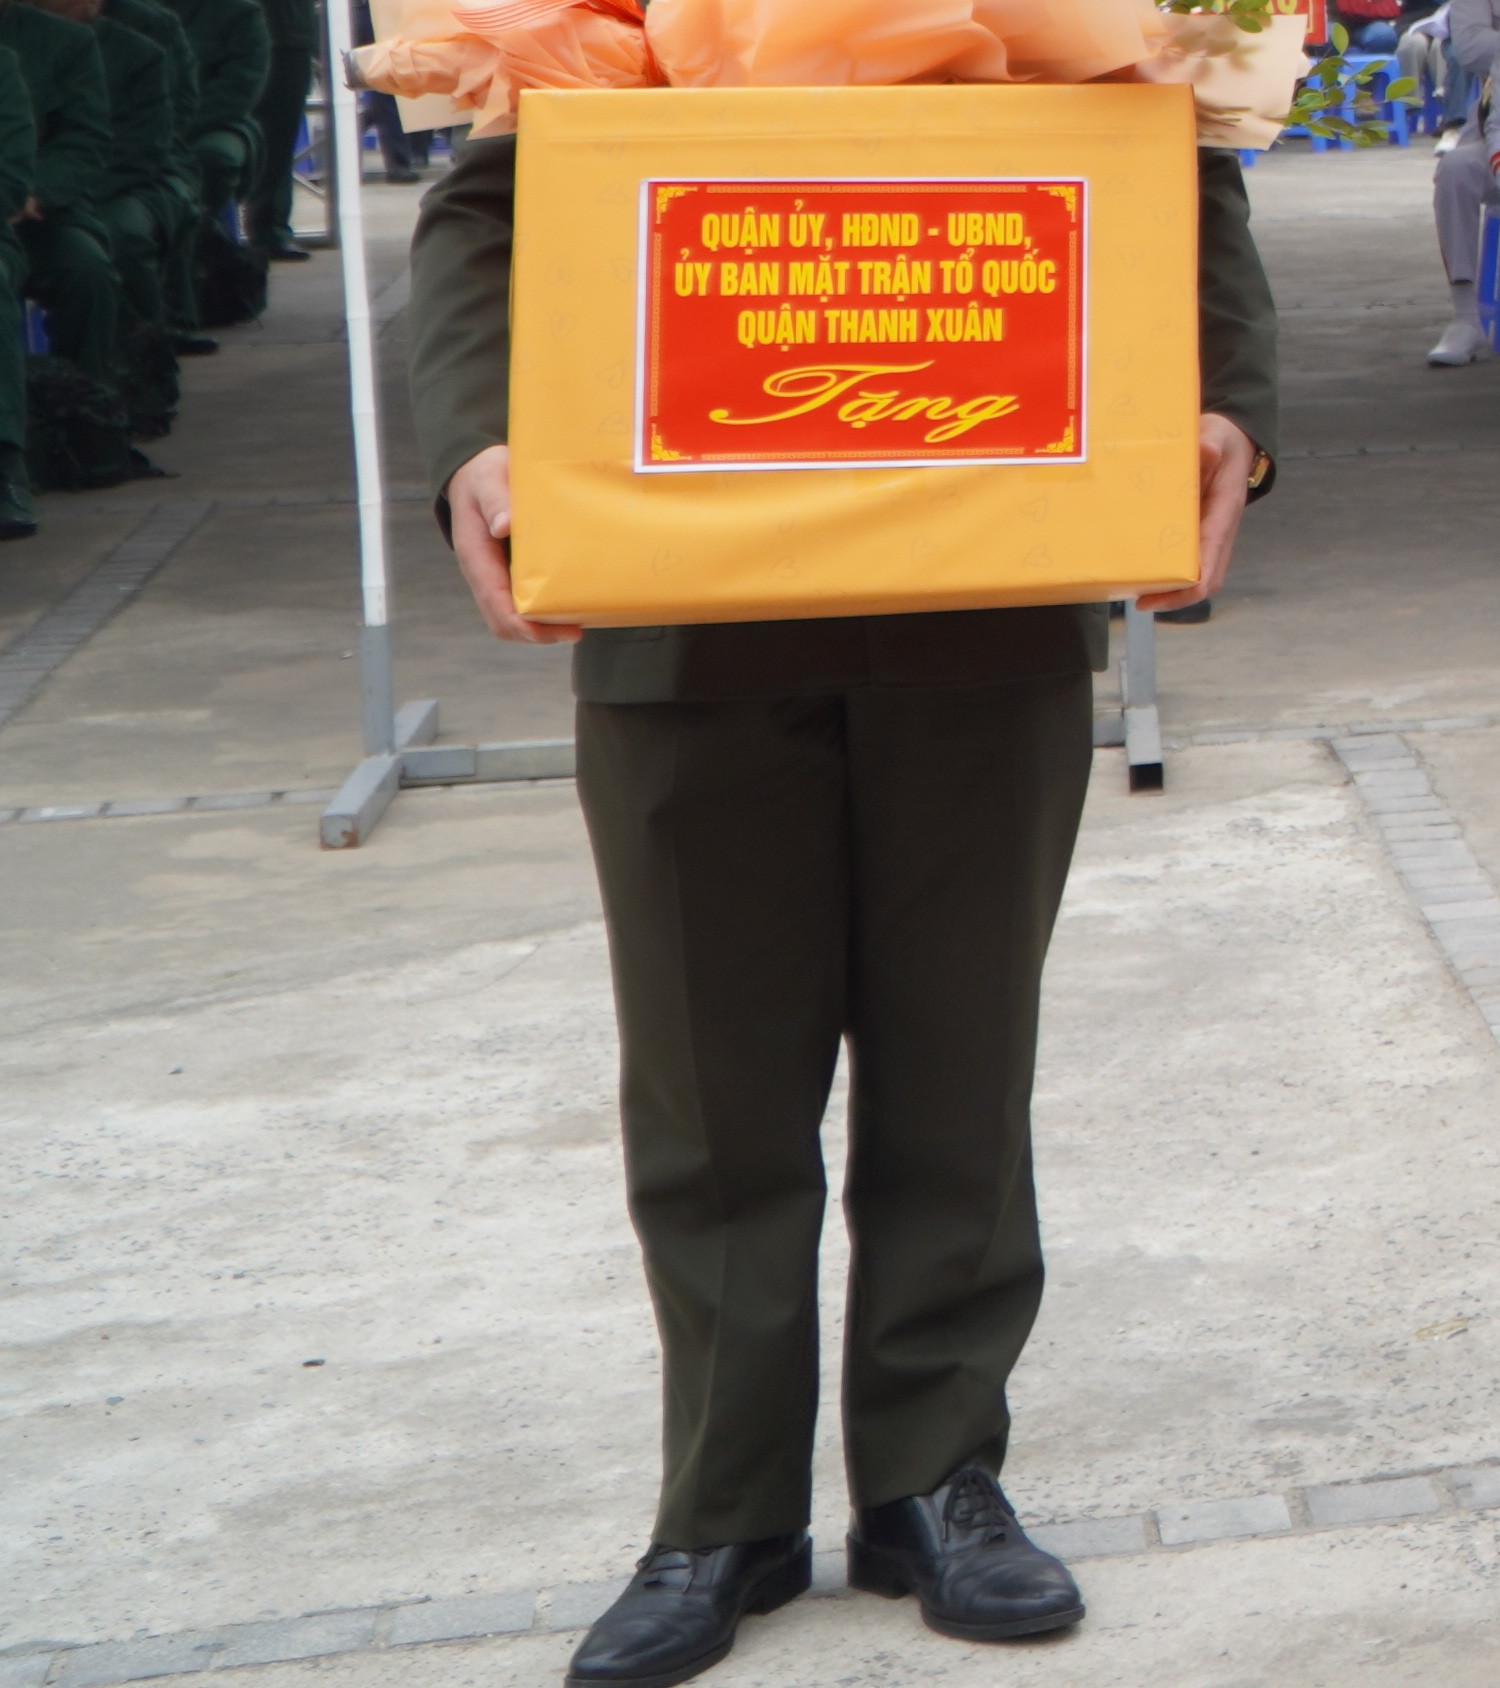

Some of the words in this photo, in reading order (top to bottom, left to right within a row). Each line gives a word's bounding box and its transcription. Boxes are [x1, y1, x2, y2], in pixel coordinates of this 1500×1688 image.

[702, 207, 779, 254] QUẬN
[789, 200, 832, 251] ỦY,
[843, 213, 918, 247] HĐND
[948, 213, 1032, 249] UBND,
[675, 248, 711, 296] ỦY
[720, 262, 779, 296] BAN
[789, 256, 849, 302] MẶT
[858, 255, 931, 301] TRẬN
[940, 247, 975, 294] TỔ
[982, 248, 1056, 297] QUỐC
[738, 303, 815, 351] QUẬN
[824, 309, 917, 344] THANH
[926, 301, 1003, 342] XUÂN
[709, 360, 1019, 443] Tặng
